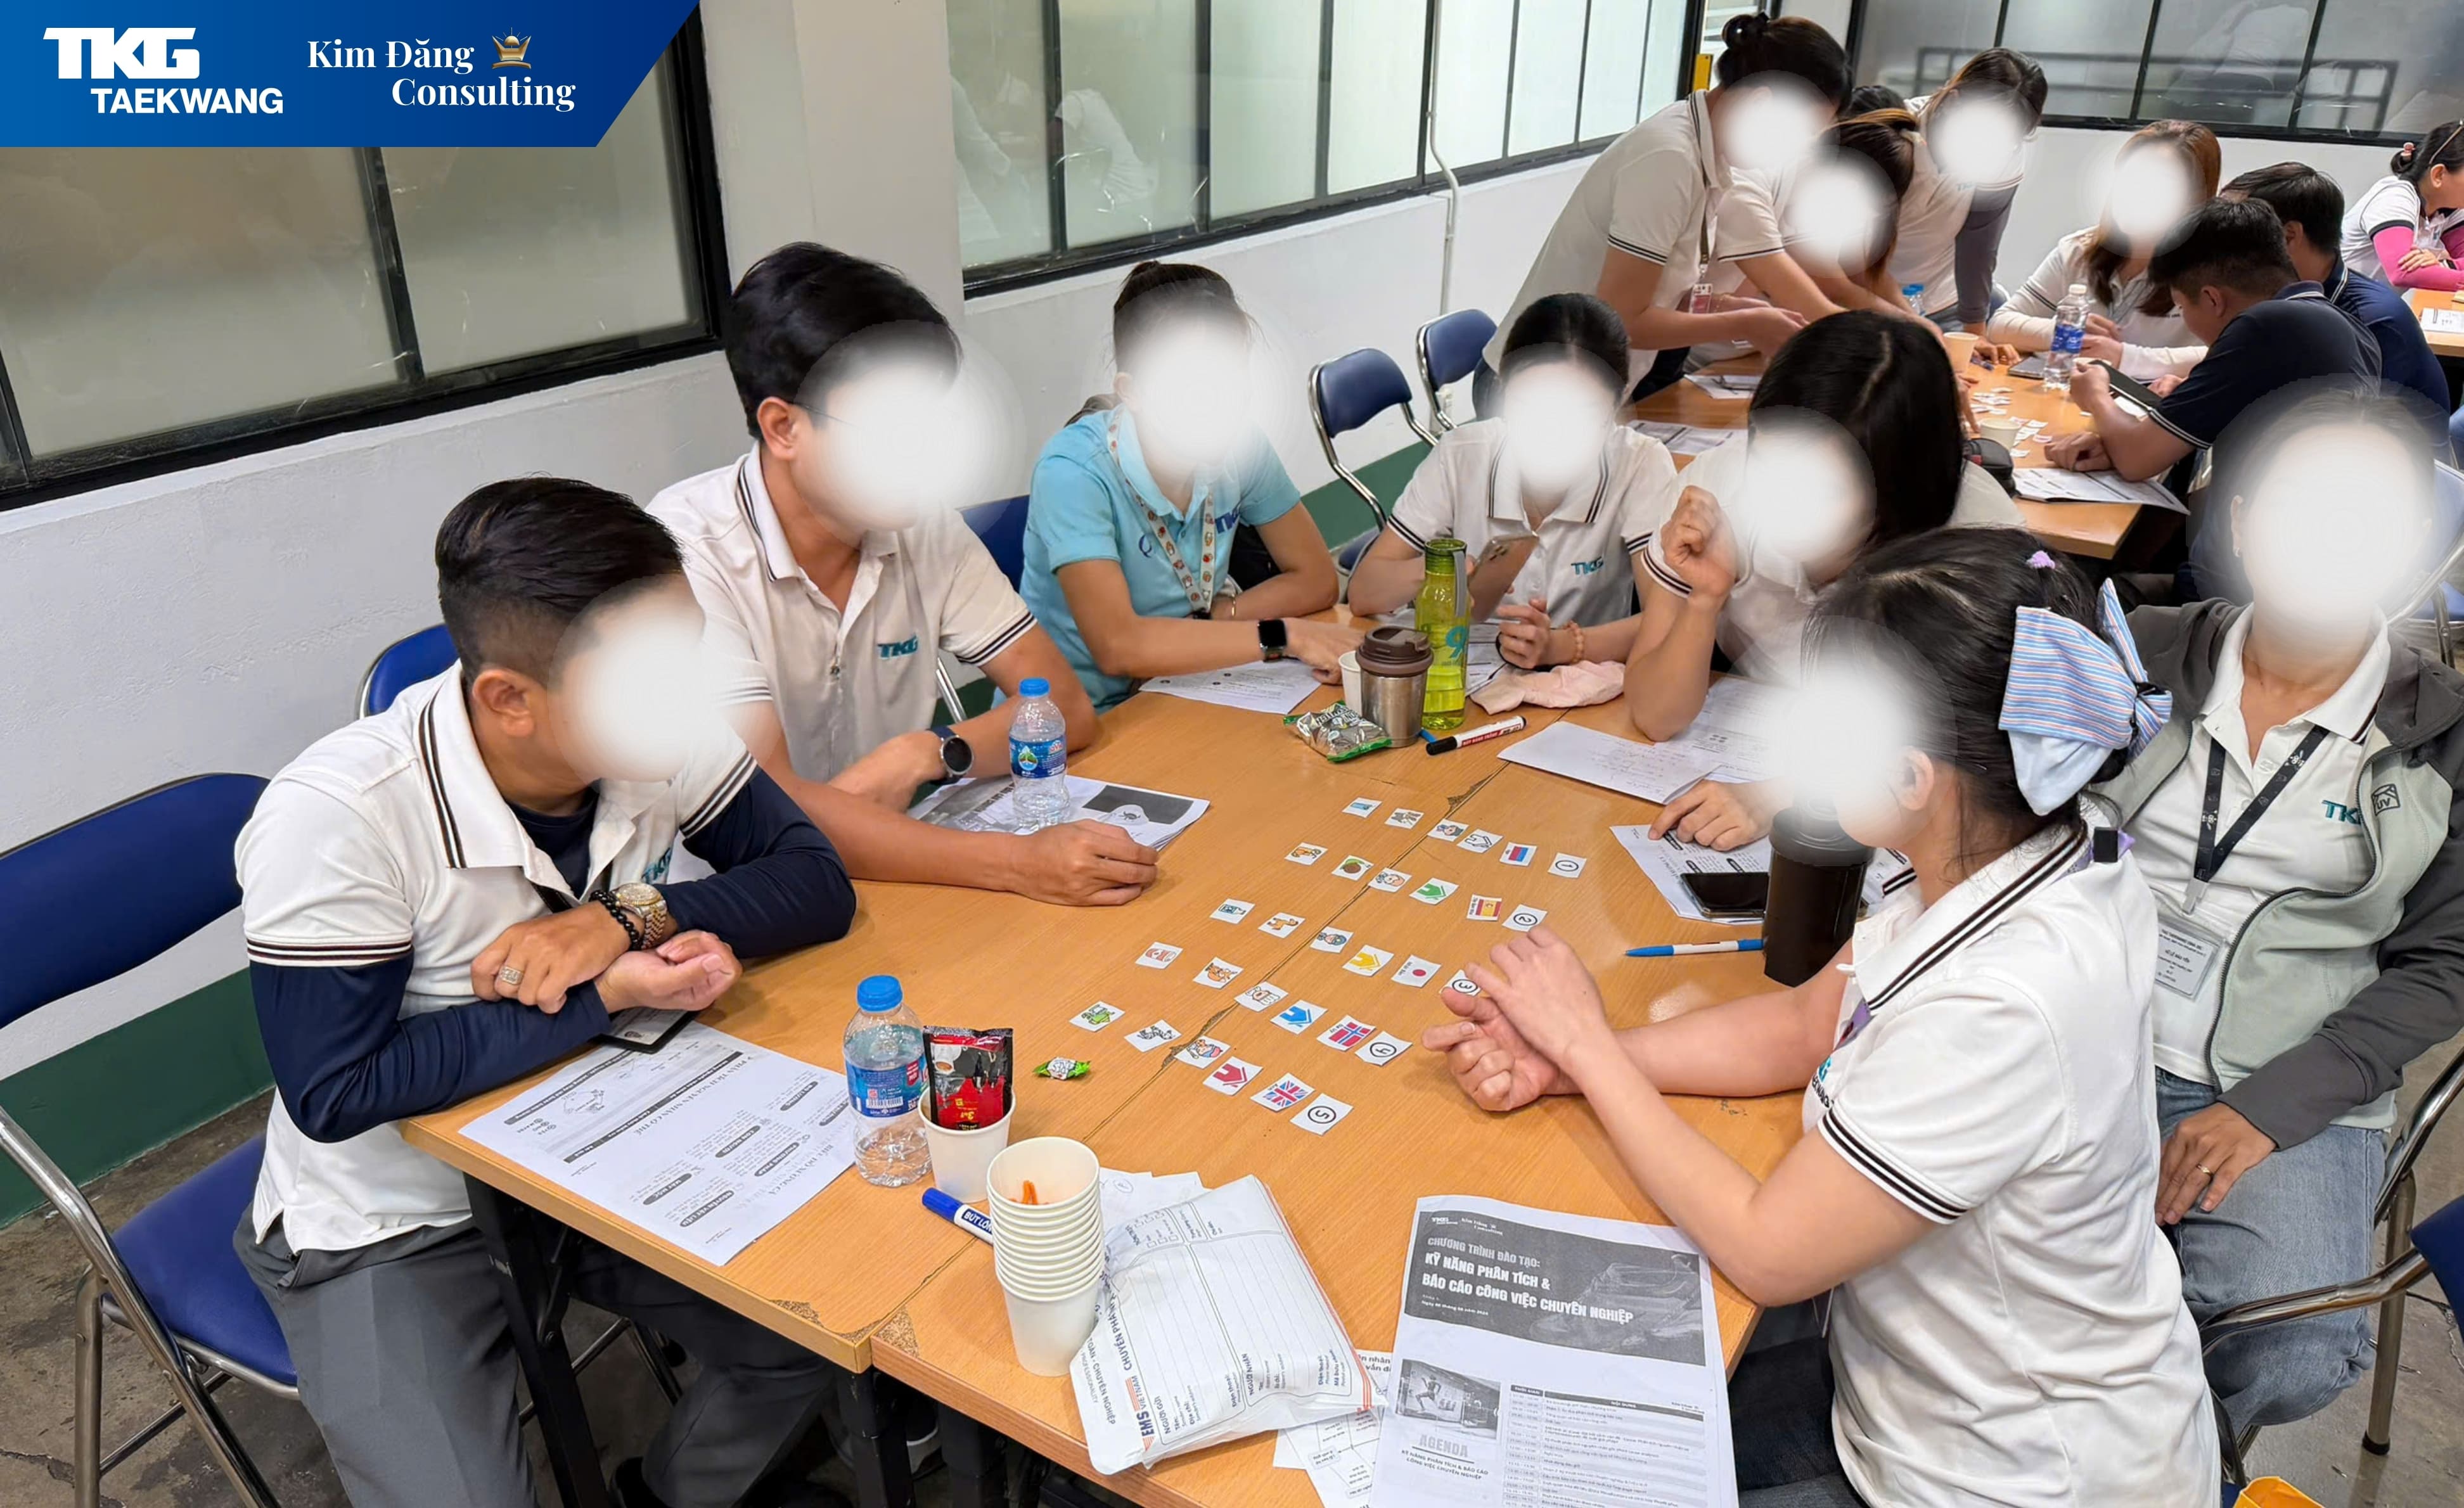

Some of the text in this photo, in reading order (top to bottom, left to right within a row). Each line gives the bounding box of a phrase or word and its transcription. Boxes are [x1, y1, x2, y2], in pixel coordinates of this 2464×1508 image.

[1571, 556, 1604, 575] TKG
[878, 635, 919, 658] TKG
[965, 1210, 993, 1232] BÚT LÔN
[1427, 1237, 1541, 1268] CHƯƠNG TRÌNH ĐÀO TẠO:
[1425, 1251, 1551, 1291] KỸ NĂNG PHÂN TÍCH &
[1421, 1271, 1634, 1326] BÁO CÁO CÔNG VIỆC CHUYÊN NGHIỆP
[1113, 1331, 1133, 1372] CHUYỂN
[1368, 1355, 1390, 1364] nhân
[1365, 1363, 1381, 1372] vấn
[1093, 1362, 1107, 1396] CHUYÊN
[1103, 1393, 1116, 1424] NGHIỆP
[1131, 1374, 1155, 1436] EMS VIETNAM
[1158, 1409, 1171, 1434] NGƯỜI
[1418, 1434, 1469, 1458] AGENDA
